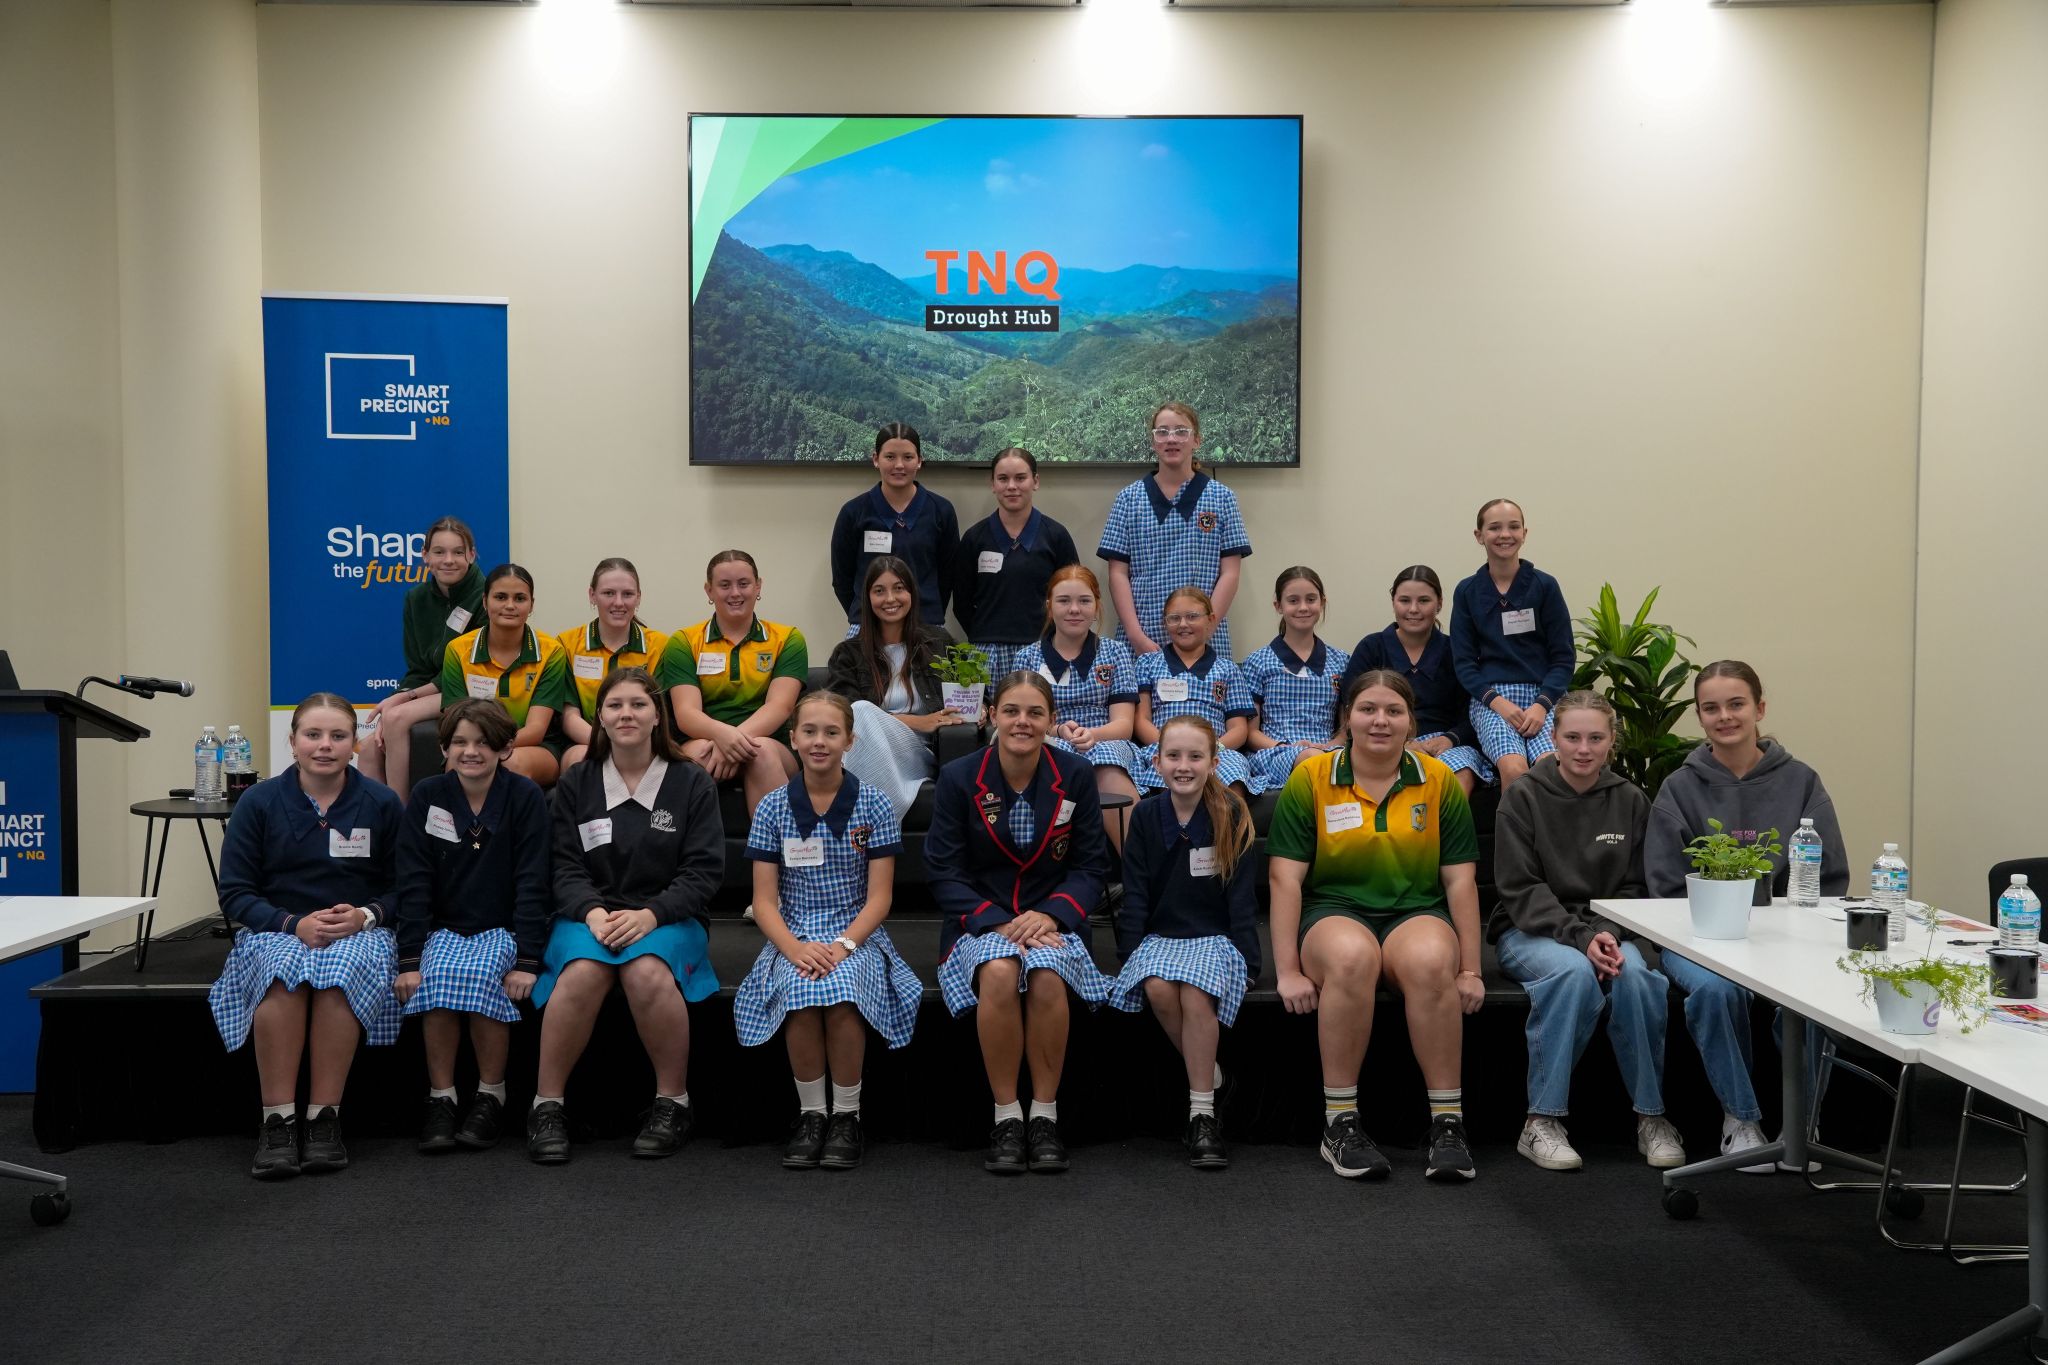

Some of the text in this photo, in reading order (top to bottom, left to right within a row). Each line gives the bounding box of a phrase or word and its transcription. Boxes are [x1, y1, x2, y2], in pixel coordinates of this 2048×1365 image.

[925, 250, 1062, 300] TNQ
[933, 309, 1052, 328] Drought Hub
[384, 383, 450, 399] SMART
[360, 398, 450, 414] PRECINCT
[326, 524, 427, 566] Shap
[333, 559, 431, 589] the futur
